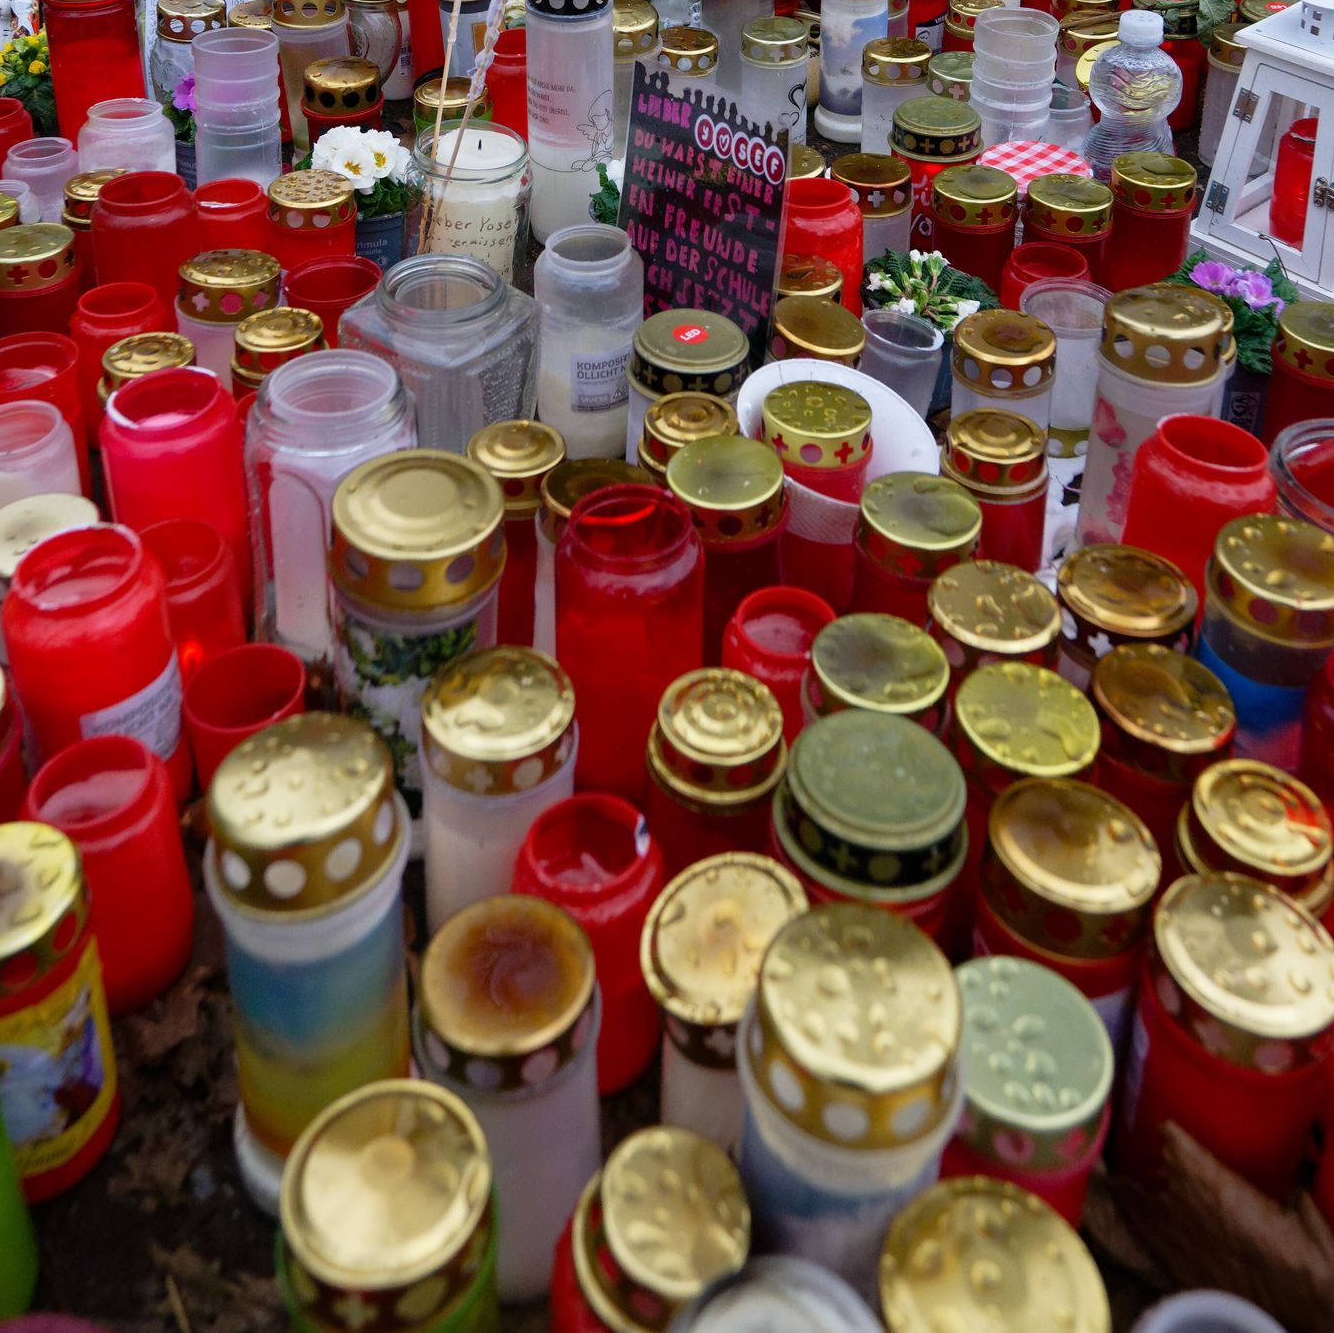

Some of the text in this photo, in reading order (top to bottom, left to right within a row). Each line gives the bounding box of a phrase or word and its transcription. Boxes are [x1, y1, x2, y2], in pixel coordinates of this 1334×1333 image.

[637, 93, 693, 128] LIEBER
[631, 153, 697, 200] MEINER
[634, 128, 654, 150] DU
[726, 165, 774, 205] EINER
[436, 213, 472, 230] eber
[629, 183, 760, 273] EN FREUNDE
[626, 218, 659, 255] AUF
[665, 238, 701, 274] DER
[703, 256, 771, 317] SCHULE
[679, 327, 701, 341] LED
[577, 367, 617, 379] ÖLLICHT
